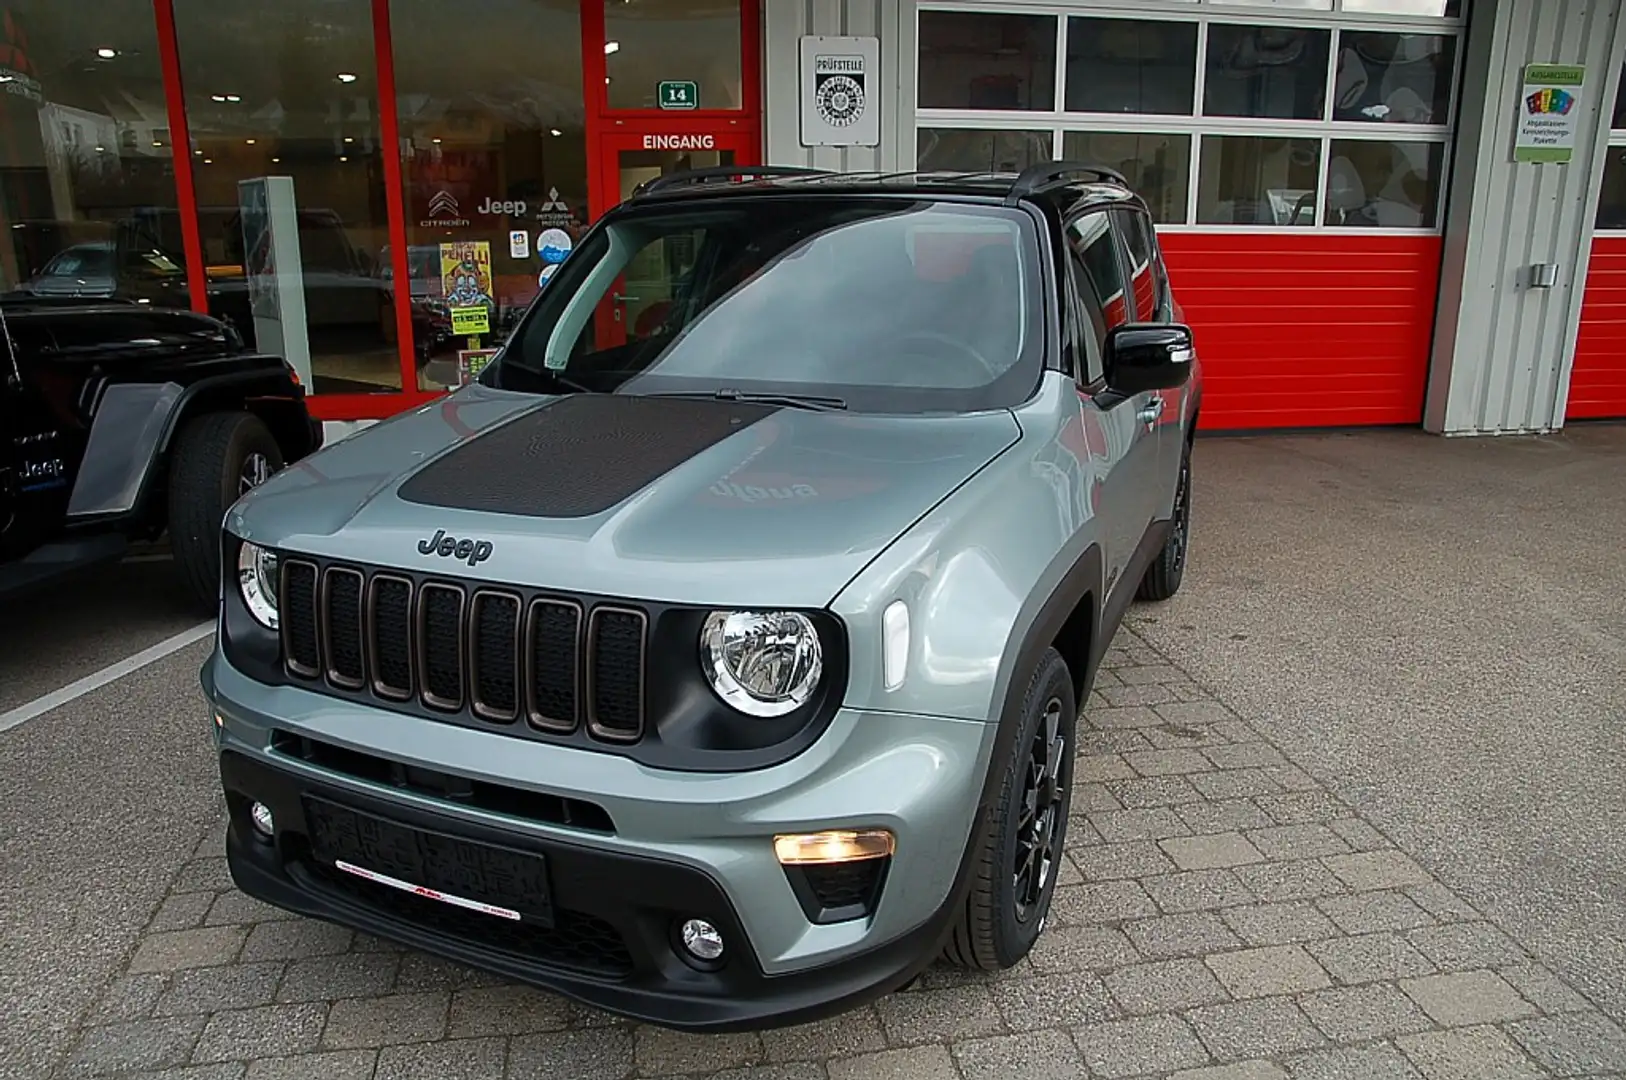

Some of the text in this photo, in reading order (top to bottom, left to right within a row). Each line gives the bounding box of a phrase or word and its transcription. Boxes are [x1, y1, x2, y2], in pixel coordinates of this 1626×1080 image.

[817, 57, 863, 71] PRÜFSTELLE
[1531, 71, 1579, 80] AUSGABESTELLE
[669, 89, 687, 101] 14
[643, 134, 715, 149] EINGANG
[478, 197, 527, 217] Jeep
[420, 218, 470, 227] CITROËN
[442, 249, 489, 264] PENELLI
[18, 457, 65, 479] Jeep
[418, 529, 494, 567] Jeep
